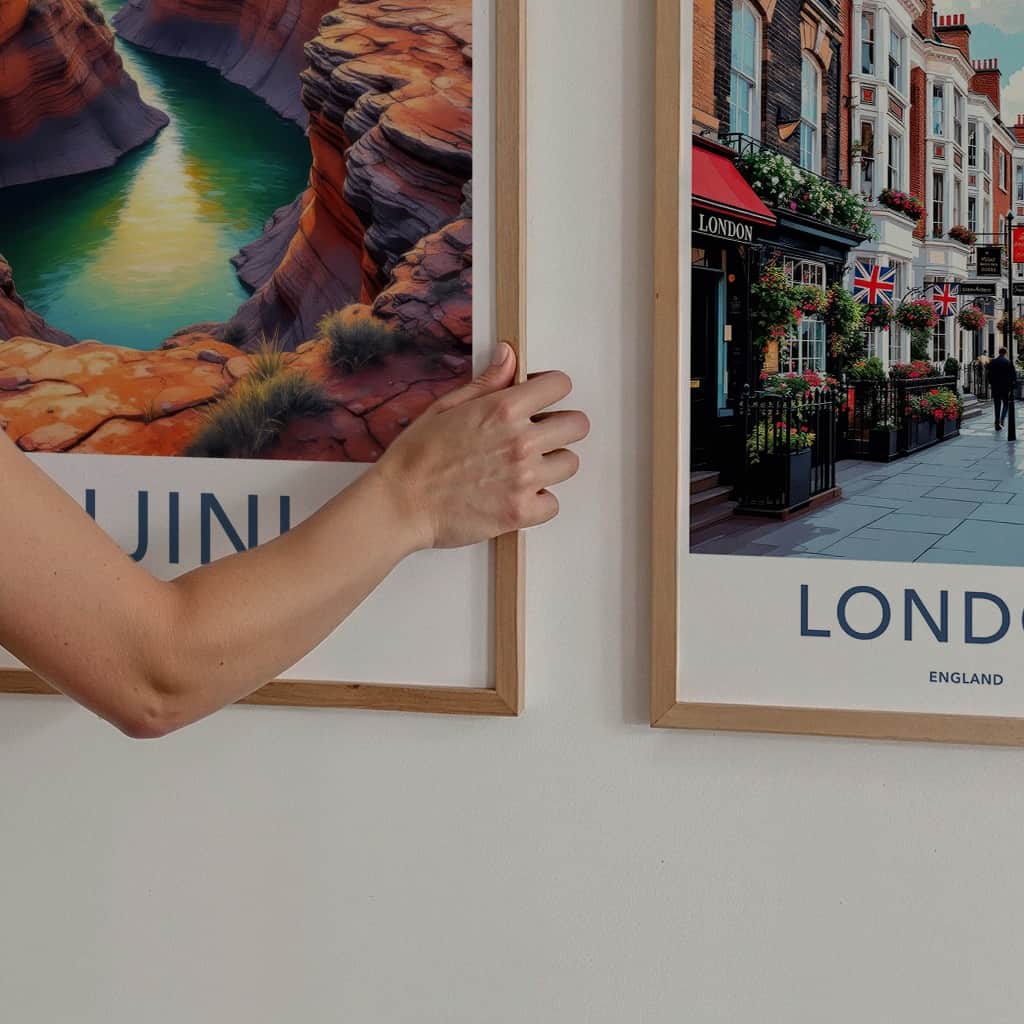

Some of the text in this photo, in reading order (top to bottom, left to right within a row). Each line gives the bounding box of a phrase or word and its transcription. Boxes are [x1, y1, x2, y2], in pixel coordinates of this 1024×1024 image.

[698, 213, 753, 242] LONDON
[800, 584, 1024, 645] LOND
[929, 671, 1004, 686] ENGLAND
